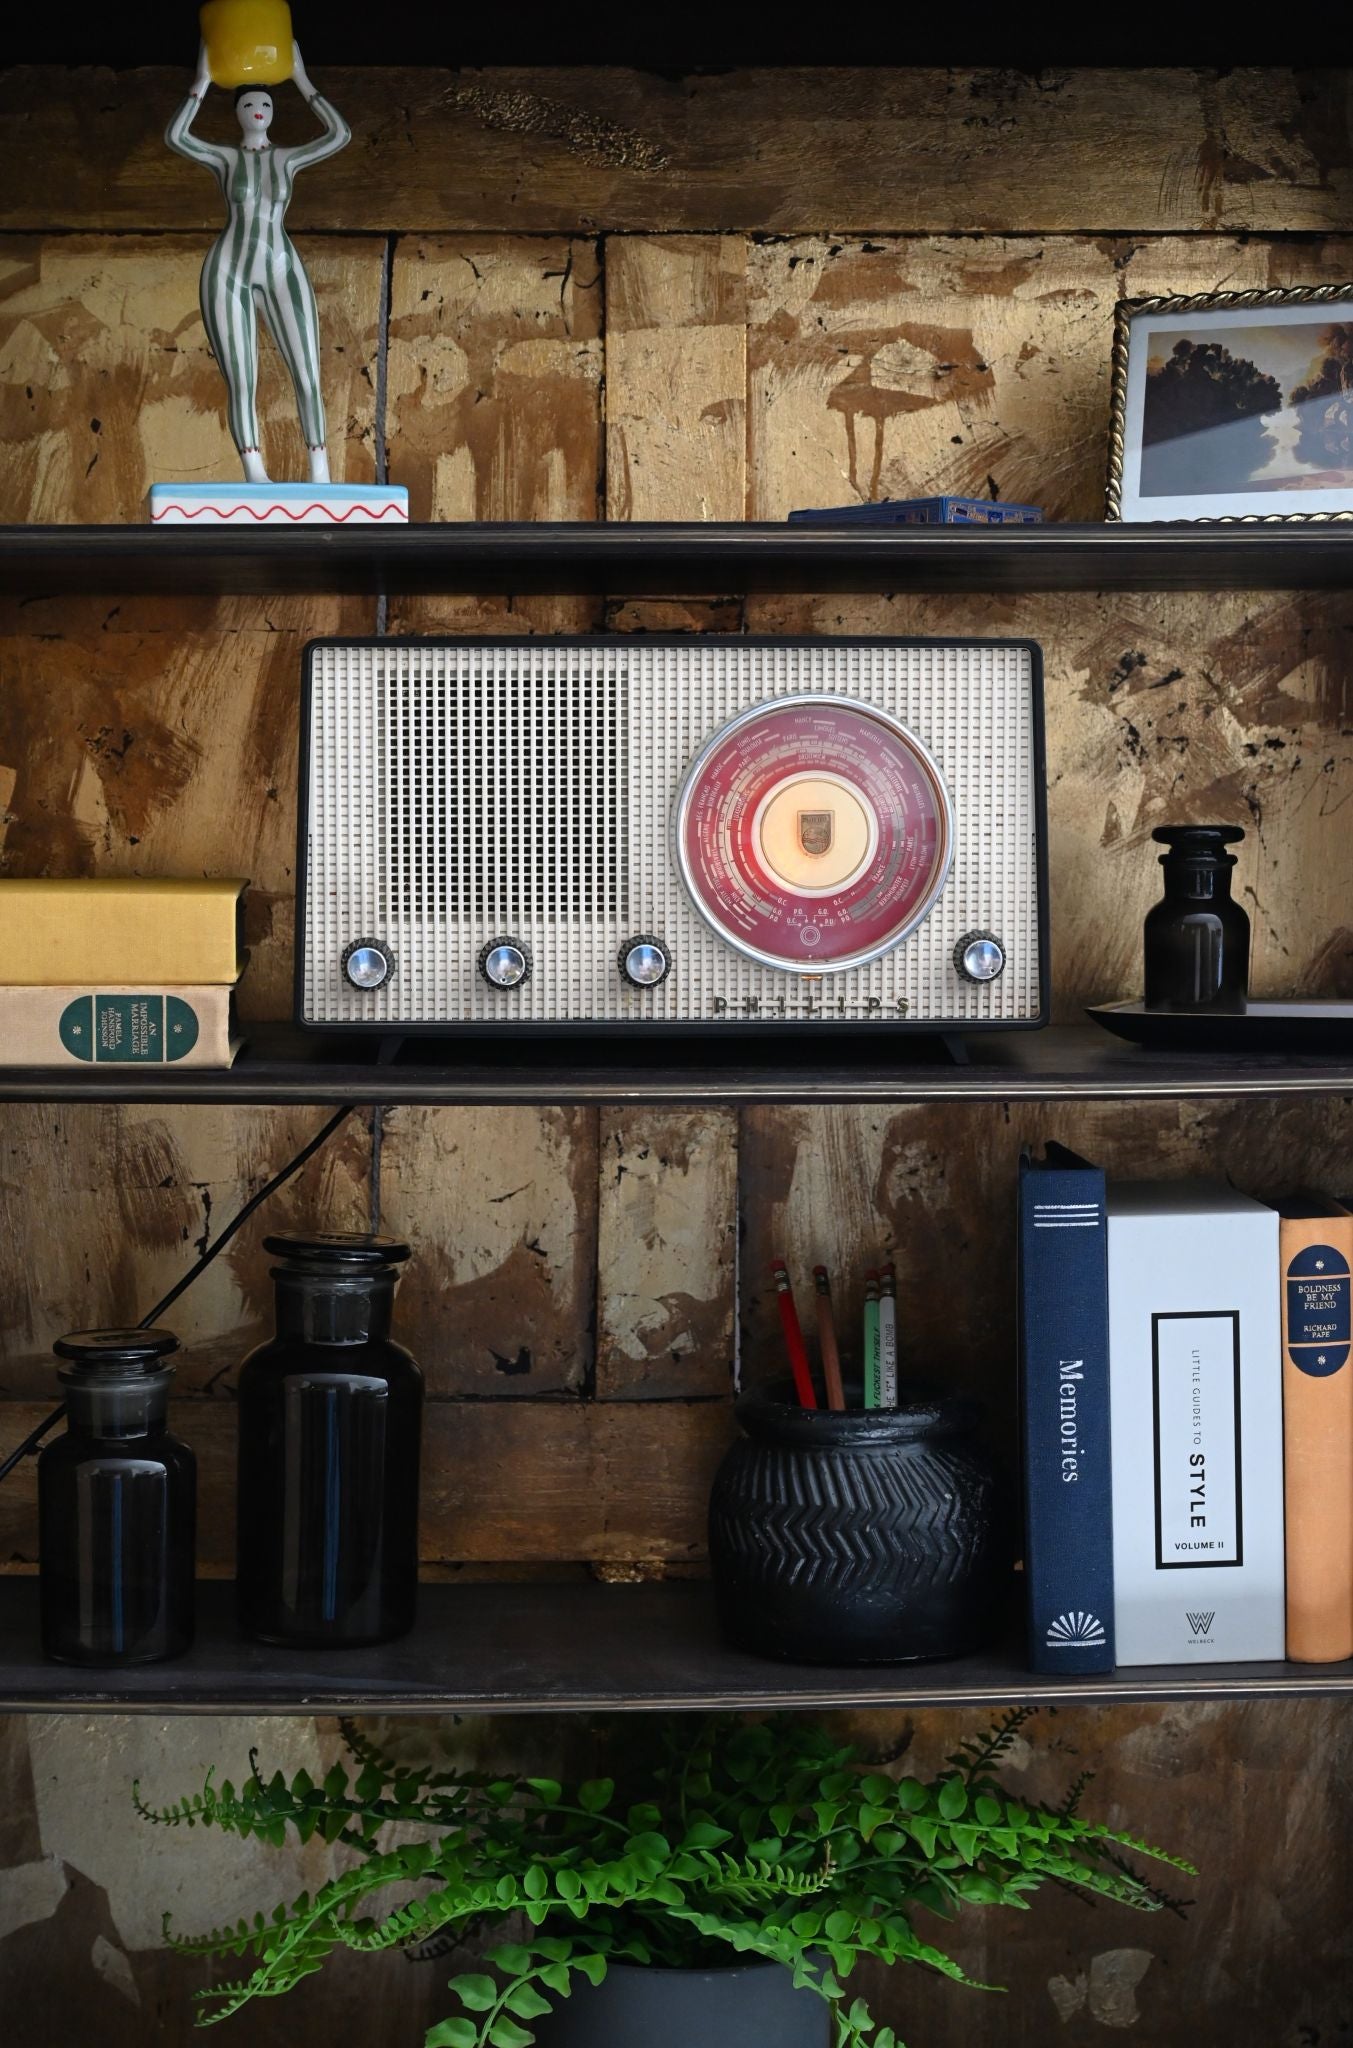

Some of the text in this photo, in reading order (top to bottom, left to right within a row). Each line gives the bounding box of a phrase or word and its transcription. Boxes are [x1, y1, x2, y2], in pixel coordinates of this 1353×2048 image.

[714, 995, 909, 1014] PHILIPS
[101, 1010, 109, 1047] JOHNSON
[108, 1007, 116, 1050] HANSFORD
[131, 1003, 140, 1054] MARRIAGE
[140, 1002, 149, 1055] IMPOSSIBLE
[149, 1021, 156, 1036] AN
[1298, 1284, 1341, 1294] BOLDNESS
[1306, 1292, 1335, 1302] BE MY
[1304, 1300, 1337, 1310] FRIEND
[885, 1323, 895, 1347] BOMB
[1303, 1323, 1337, 1332] RICHARD
[885, 1360, 895, 1378] LIKE
[1192, 1349, 1202, 1445] LITTLE GUIDES TO
[1059, 1359, 1085, 1482] Memories
[1189, 1453, 1206, 1528] STYLE
[1174, 1541, 1224, 1550] VOLUME II
